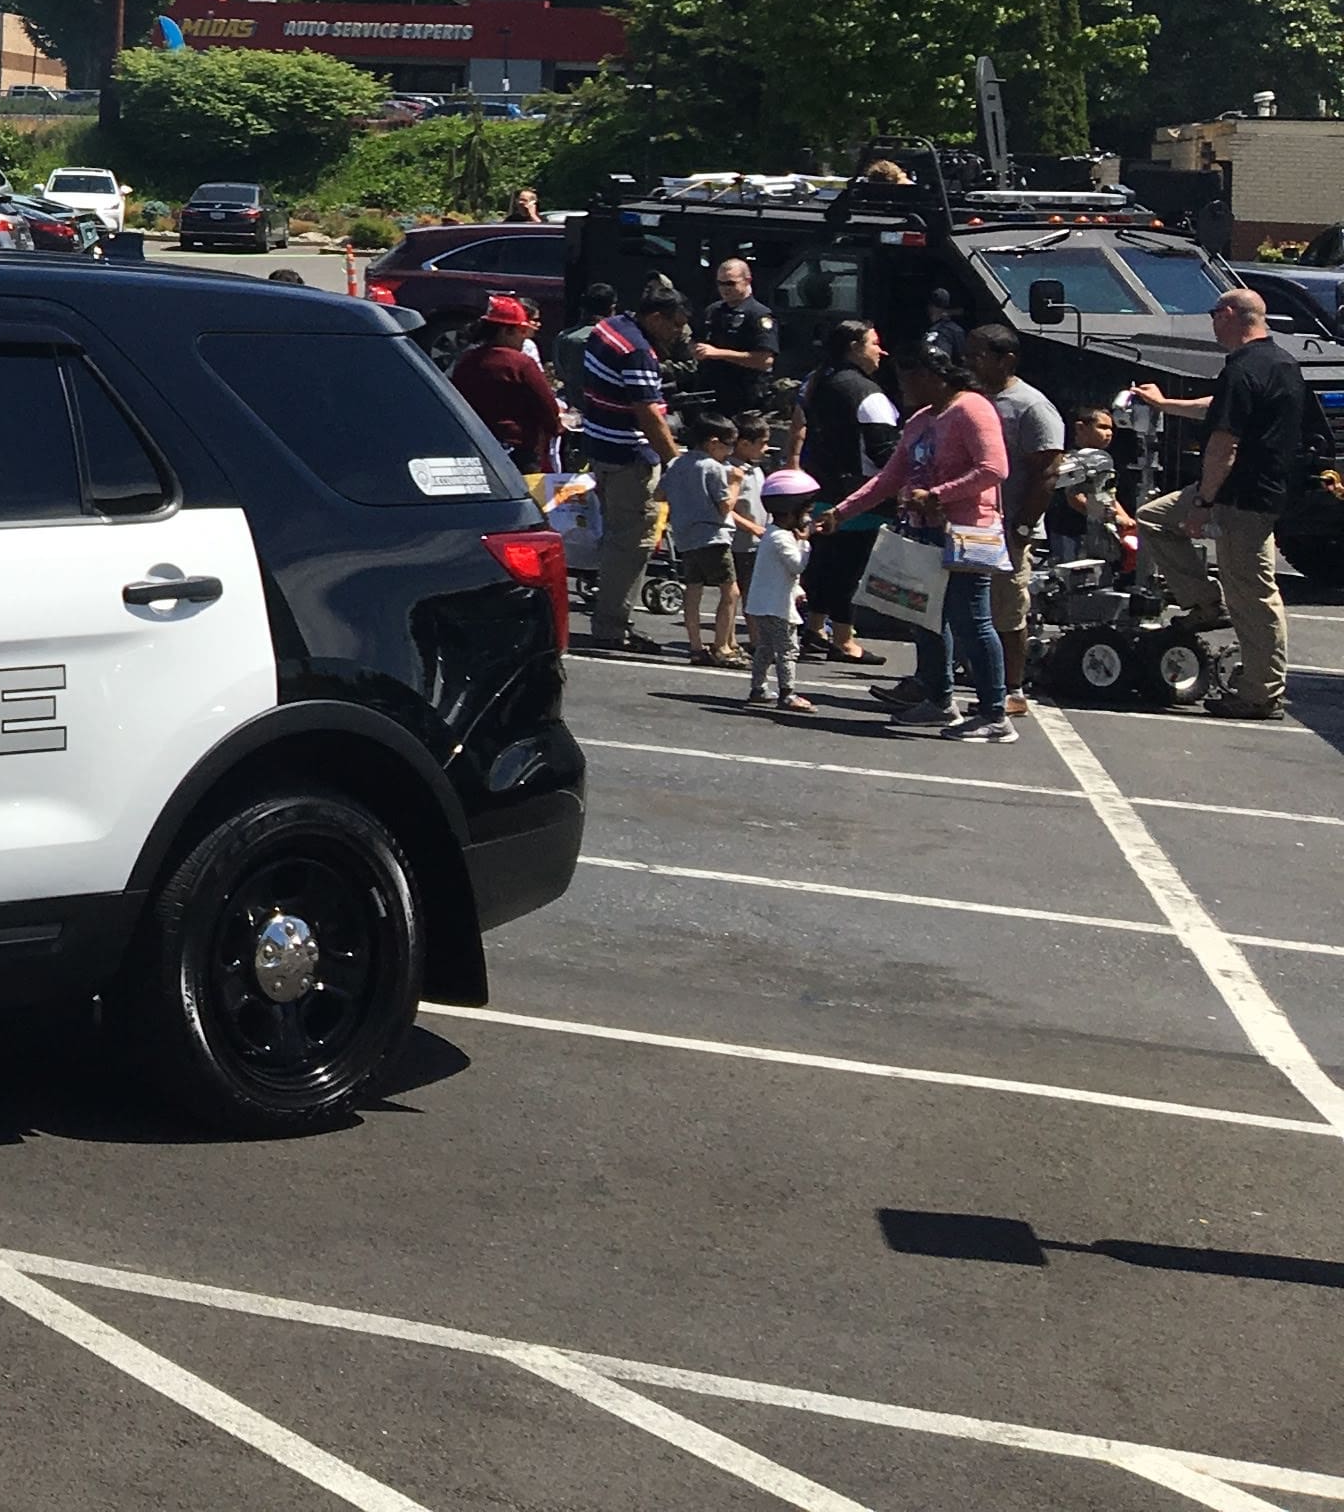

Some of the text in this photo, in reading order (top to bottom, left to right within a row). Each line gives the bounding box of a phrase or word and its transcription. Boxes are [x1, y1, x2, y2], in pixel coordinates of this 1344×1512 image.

[181, 18, 254, 38] MIDAS
[284, 20, 473, 41] AUTO SERVICE EXPERTS
